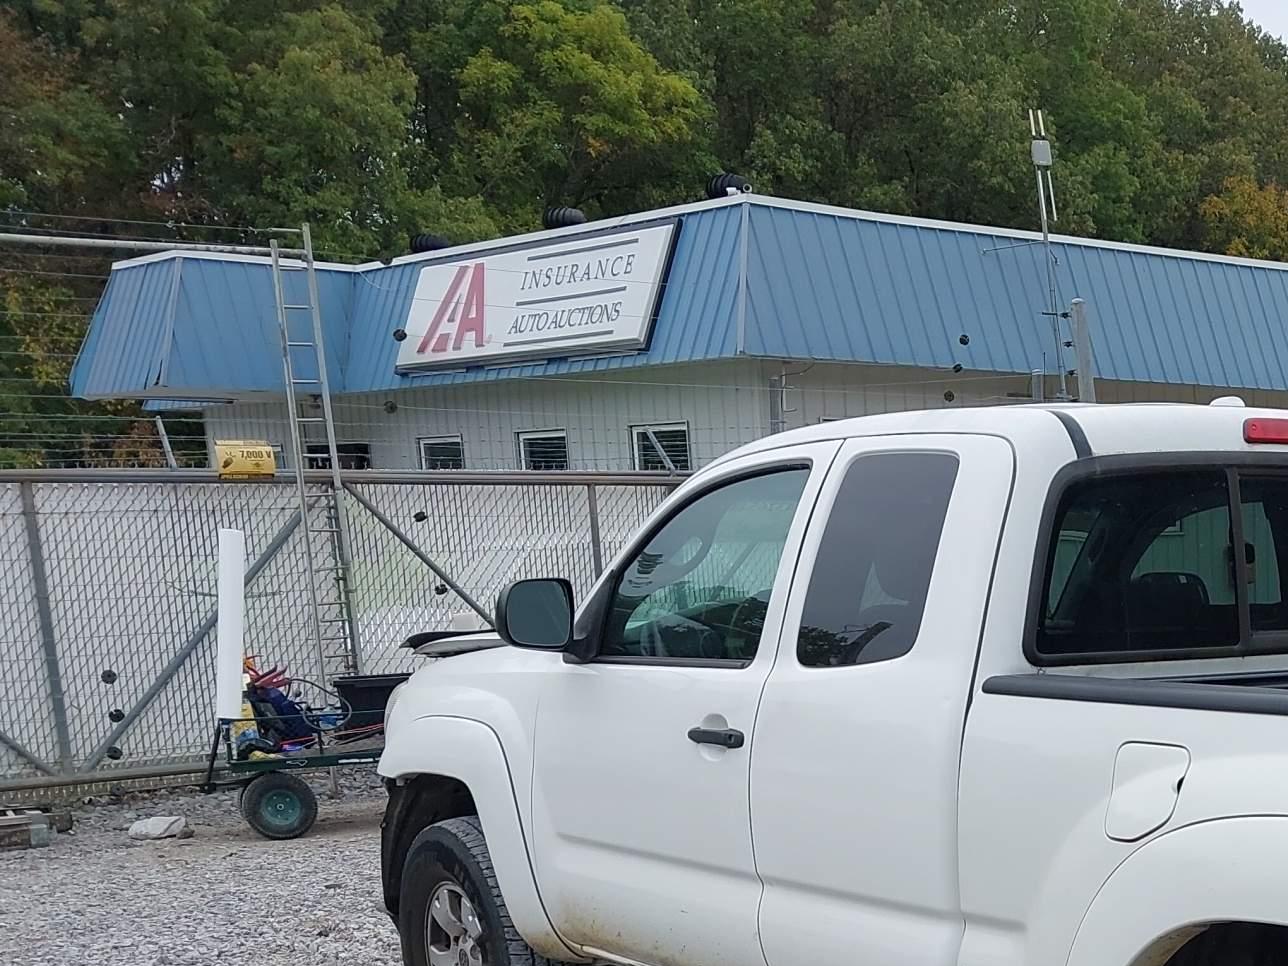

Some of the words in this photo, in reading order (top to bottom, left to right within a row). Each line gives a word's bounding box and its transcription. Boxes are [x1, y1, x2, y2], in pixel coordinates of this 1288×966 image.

[520, 254, 636, 291] INSURANCE
[507, 311, 550, 335] AUTO
[547, 301, 623, 330] AUCTIONS
[239, 450, 264, 460] 7,000
[265, 450, 272, 459] V
